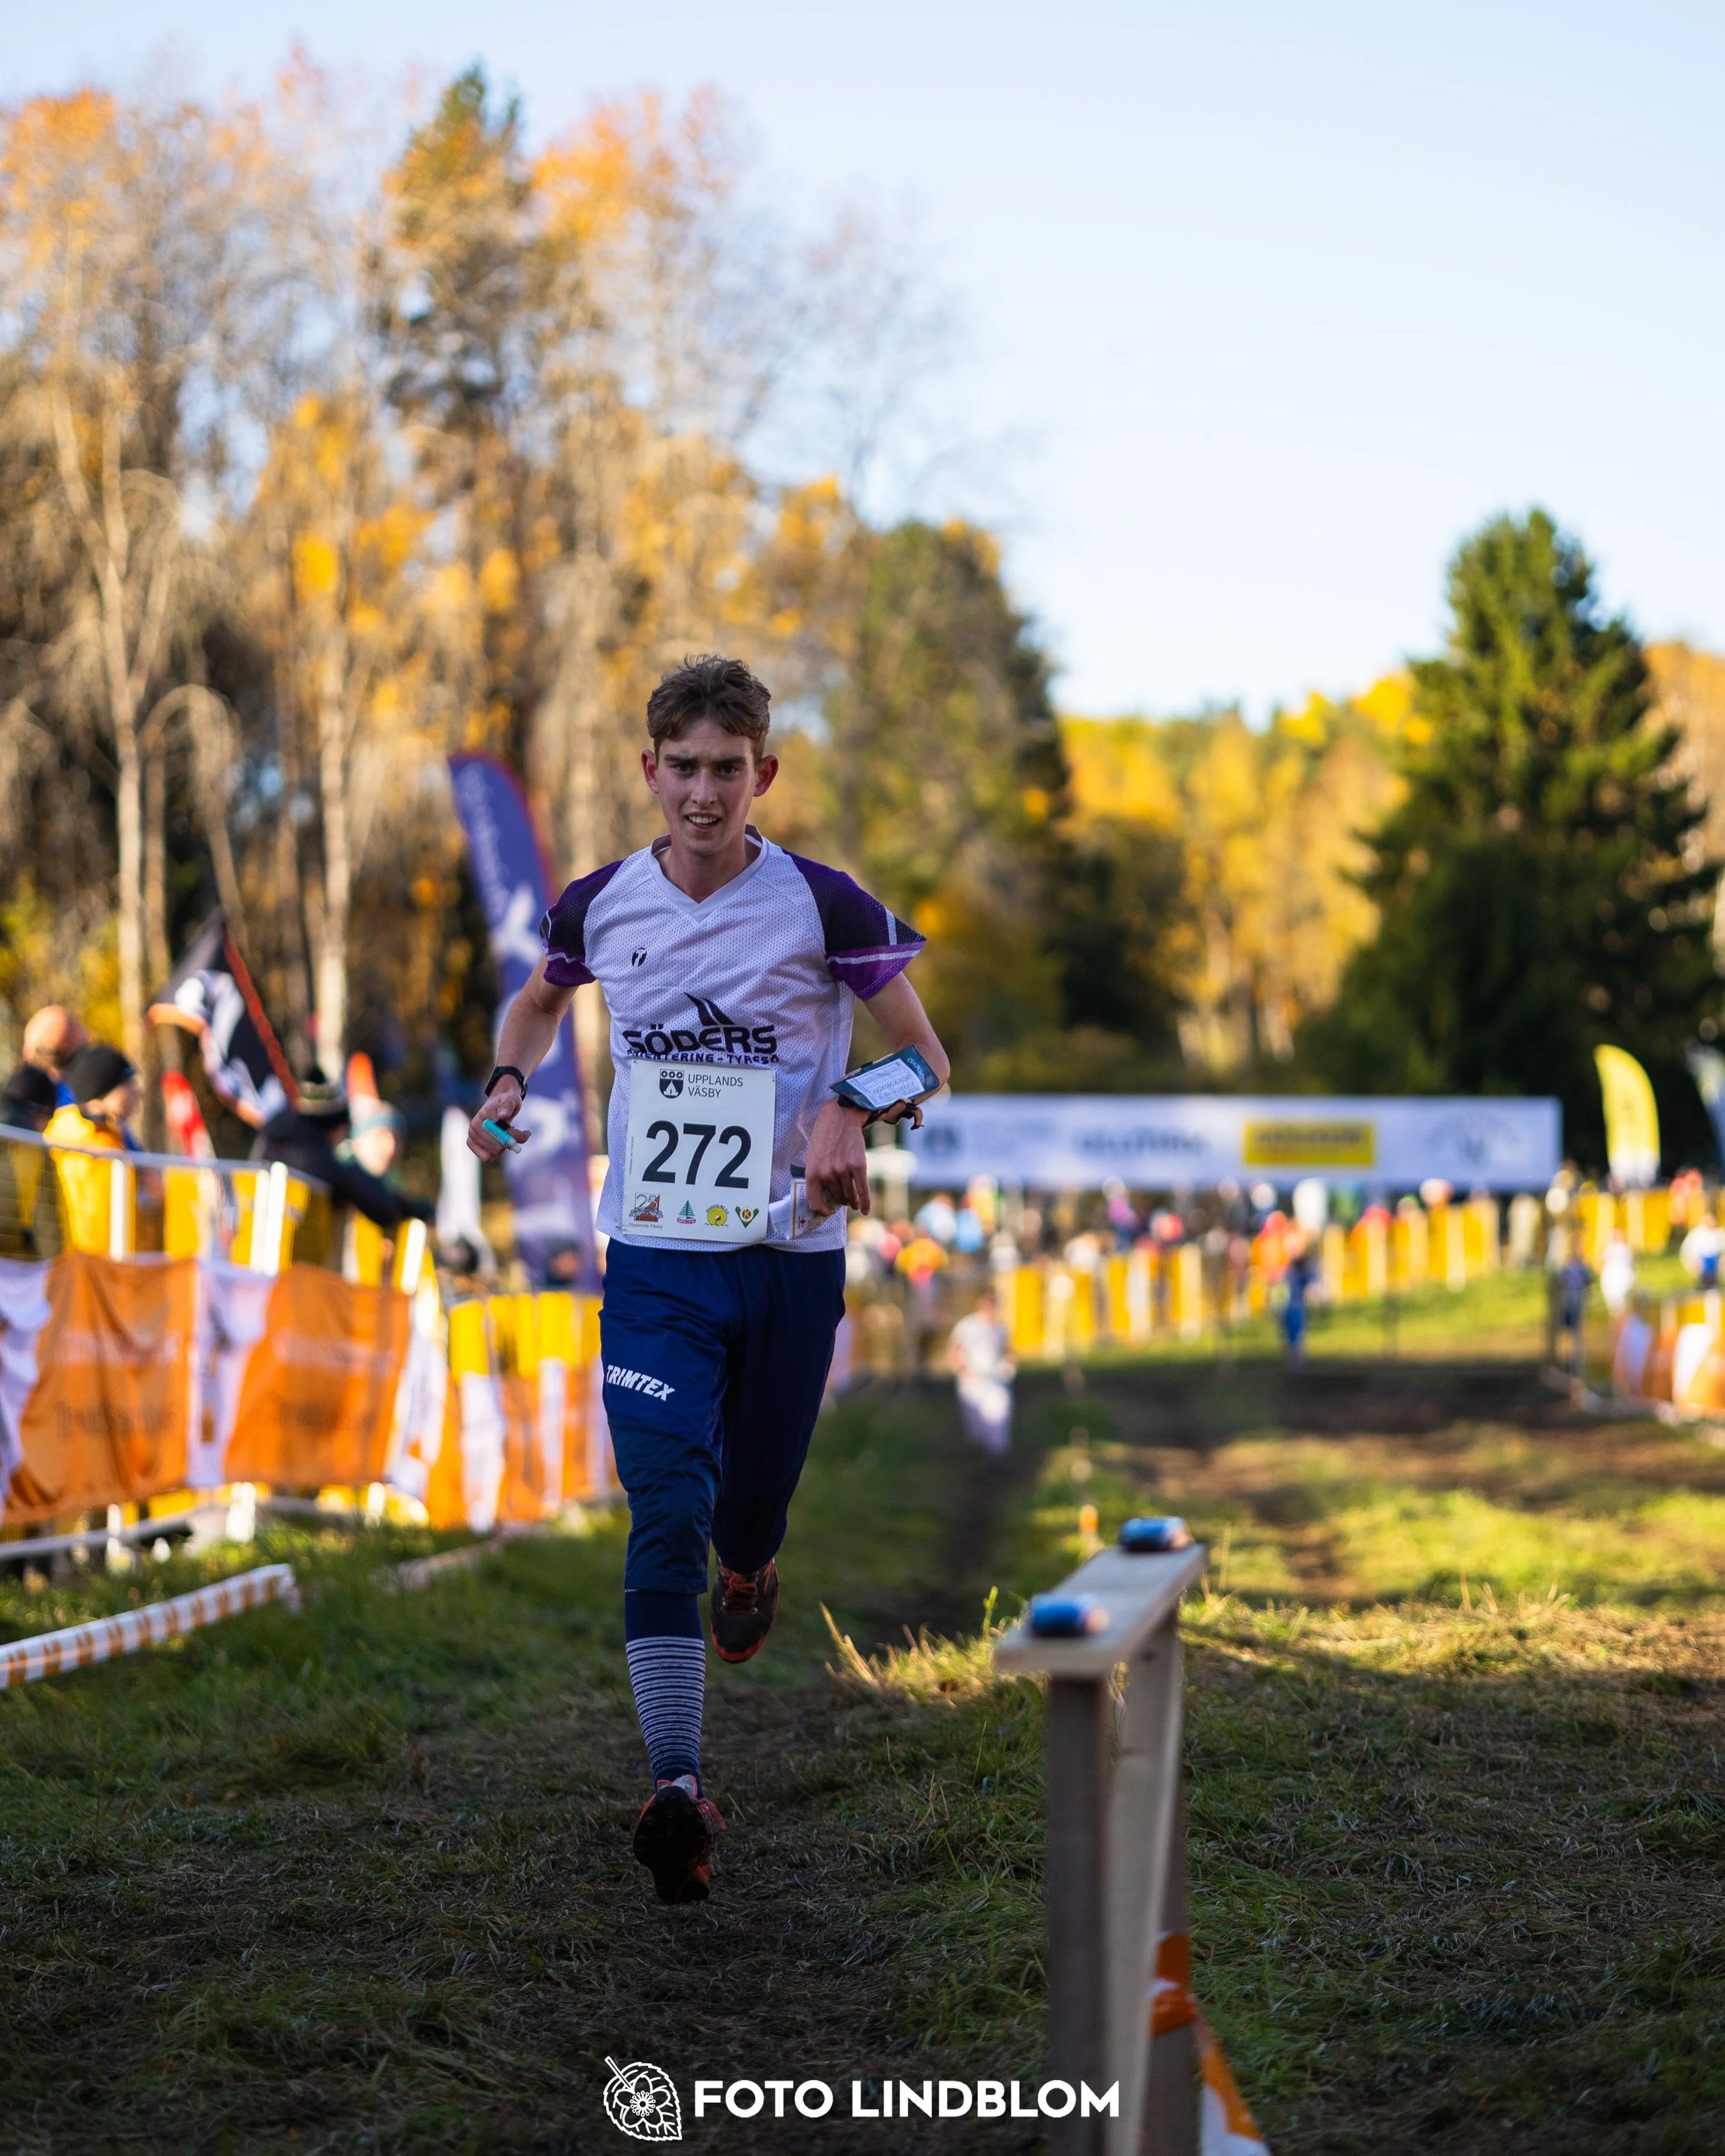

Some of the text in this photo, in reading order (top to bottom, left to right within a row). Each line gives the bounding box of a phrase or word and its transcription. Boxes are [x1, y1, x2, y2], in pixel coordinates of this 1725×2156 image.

[622, 1024, 778, 1055] SÖDERS
[727, 1054, 780, 1065] TYRESÖ
[688, 1074, 744, 1087] UPPLANDS
[688, 1085, 722, 1098] VÄSBY
[642, 1120, 751, 1189] 272
[636, 1194, 658, 1210] 25
[606, 1364, 676, 1401] TRIMTEX
